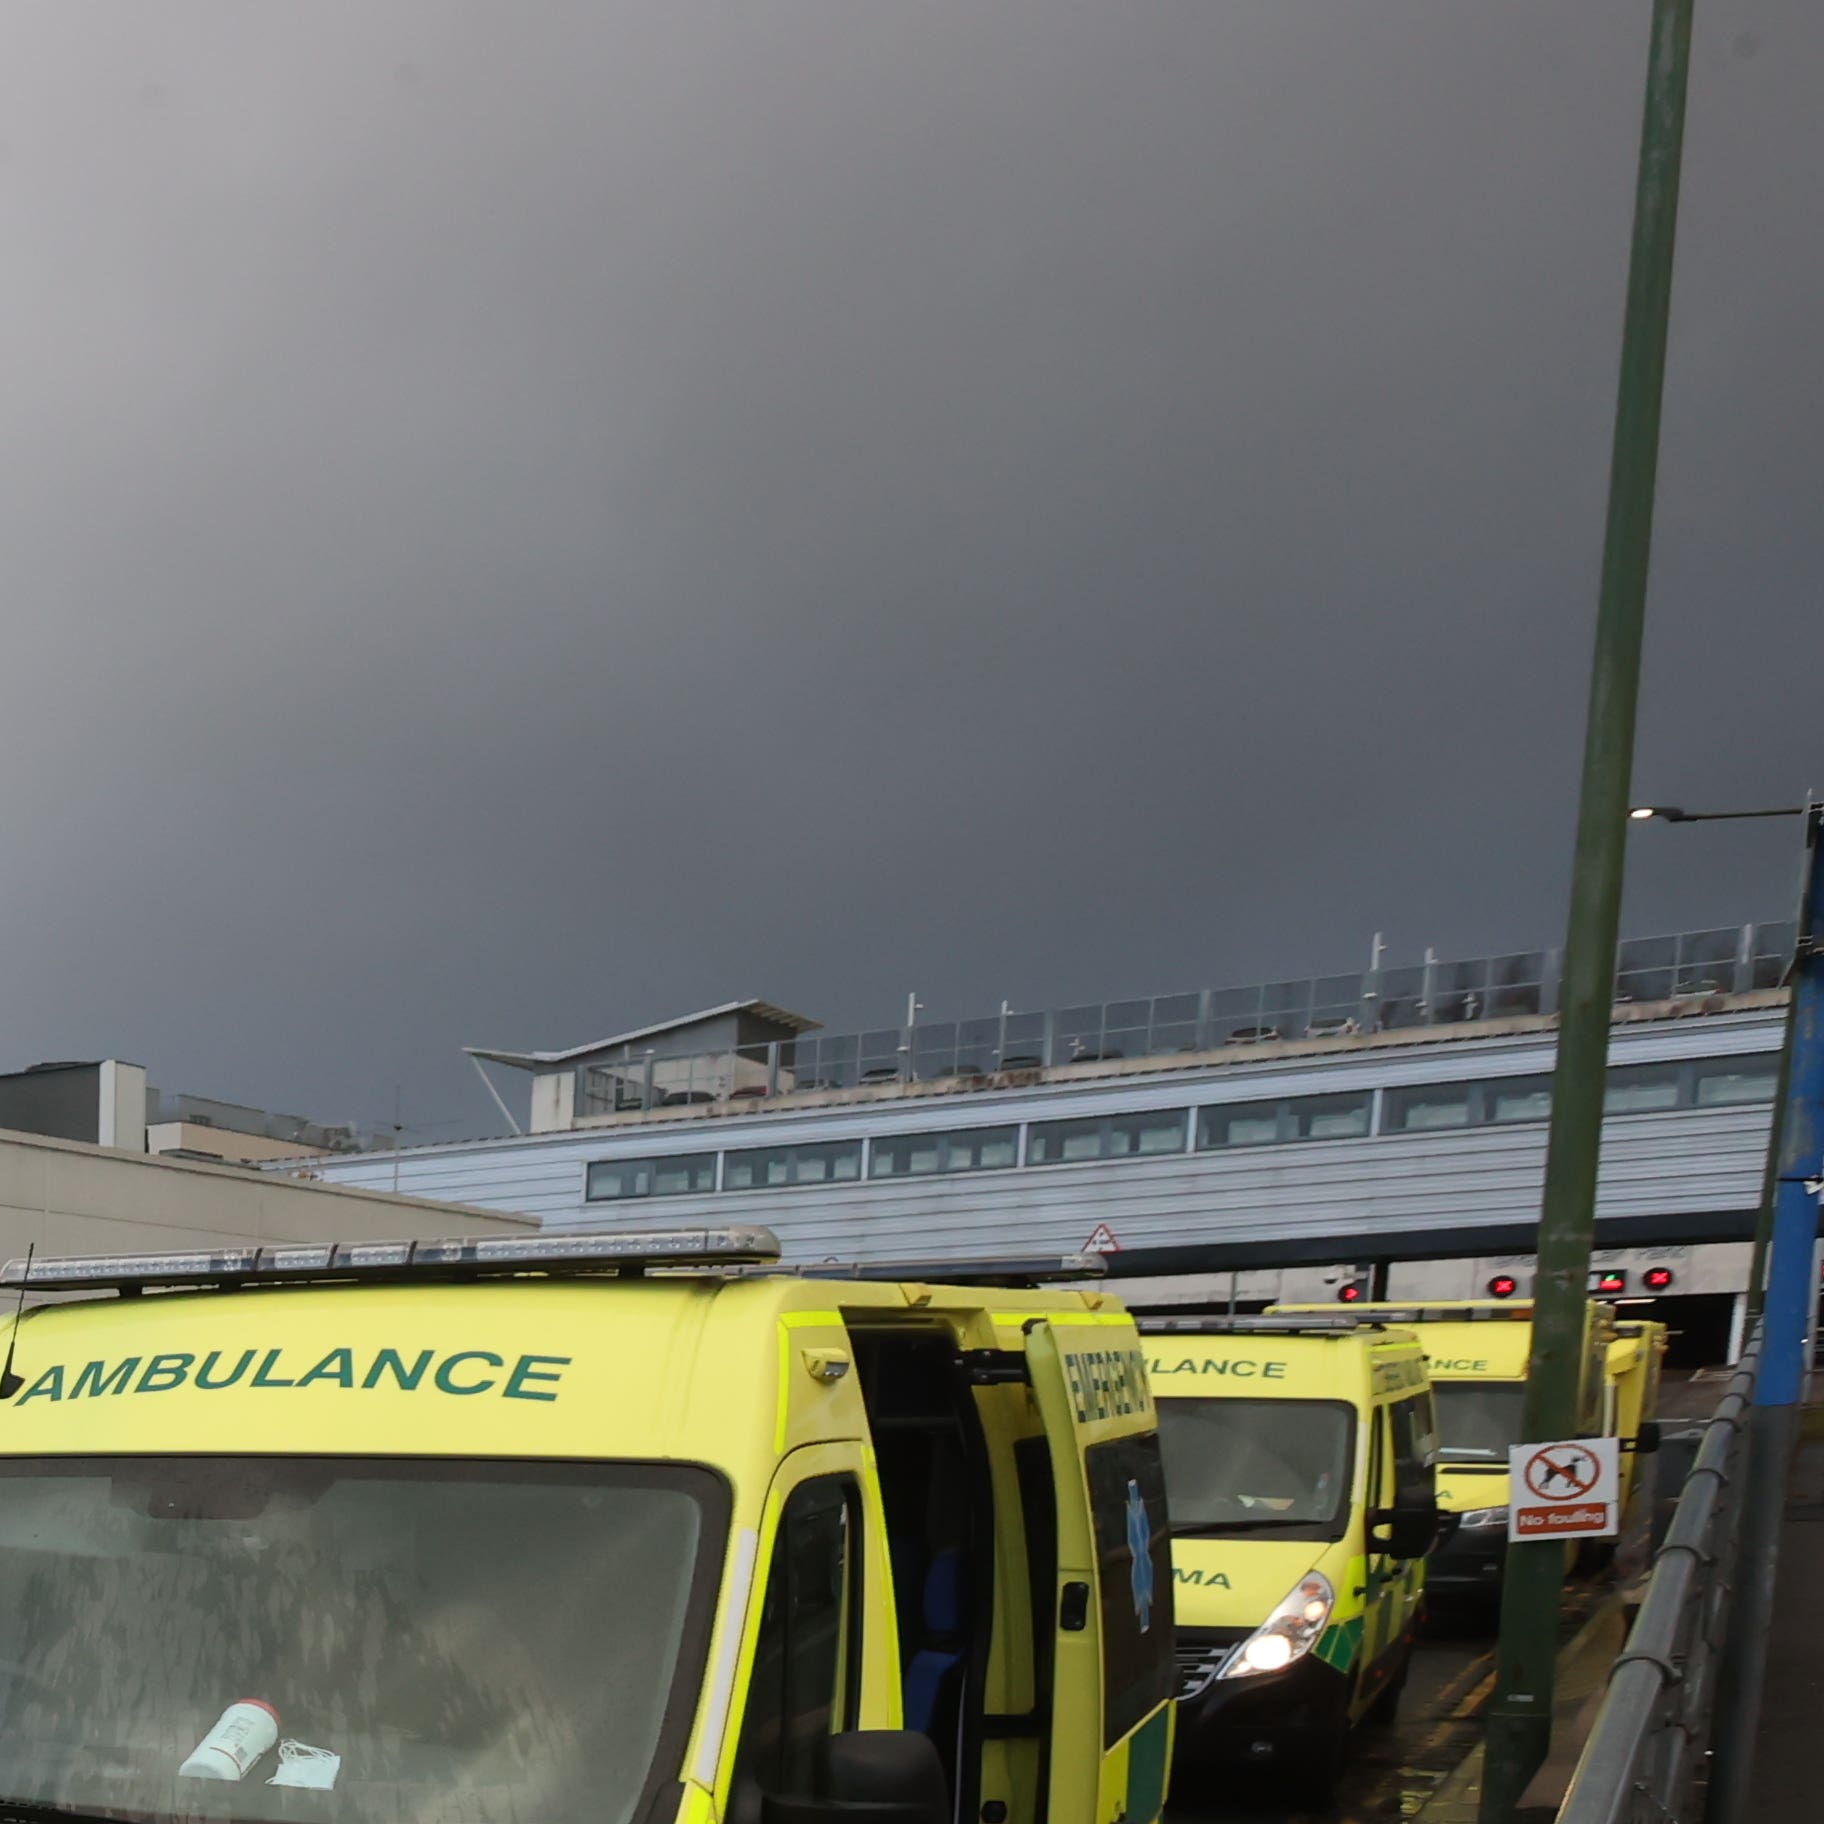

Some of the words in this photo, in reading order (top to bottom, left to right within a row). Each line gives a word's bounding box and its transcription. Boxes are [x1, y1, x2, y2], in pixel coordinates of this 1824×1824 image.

[13, 1347, 572, 1407] AMBULANCE
[1150, 1358, 1288, 1379] LANCE
[1519, 1514, 1545, 1527] No
